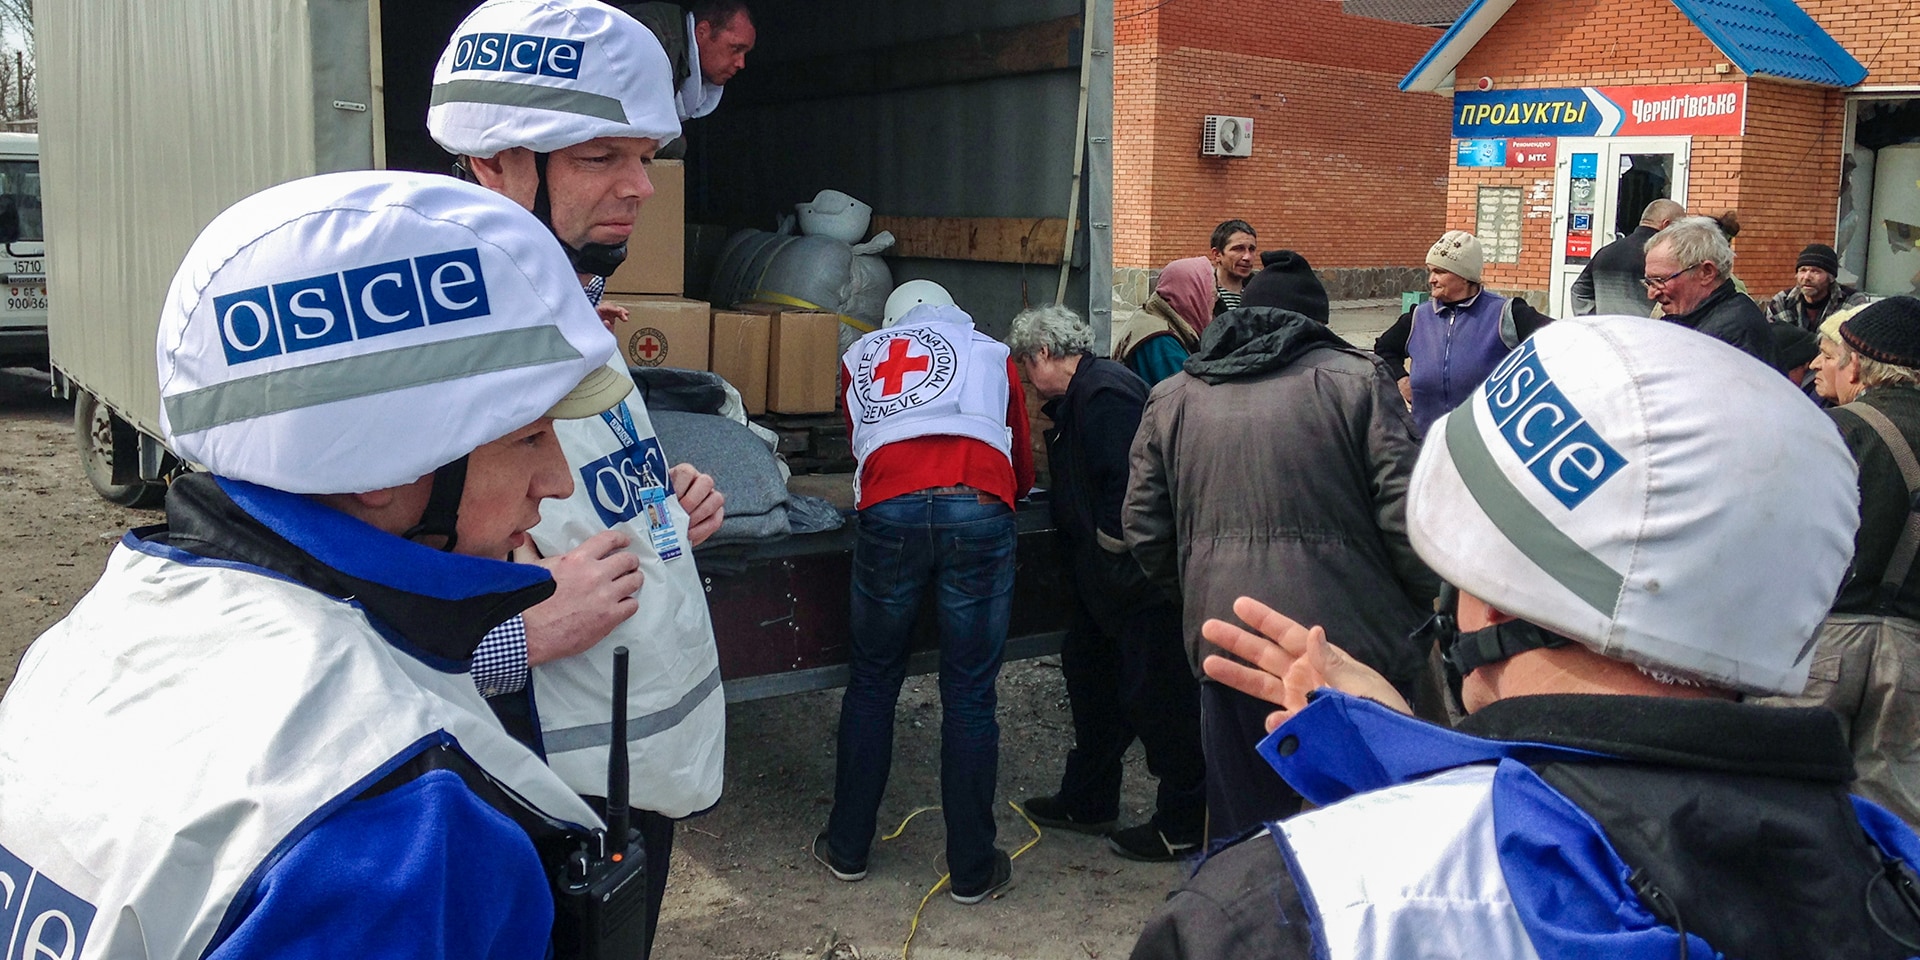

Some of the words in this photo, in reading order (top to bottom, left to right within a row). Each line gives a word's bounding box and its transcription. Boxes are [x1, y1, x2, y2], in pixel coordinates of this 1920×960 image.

[1459, 101, 1587, 125] ПРОДУКТЫ
[13, 260, 41, 273] 15710
[23, 287, 35, 297] GE
